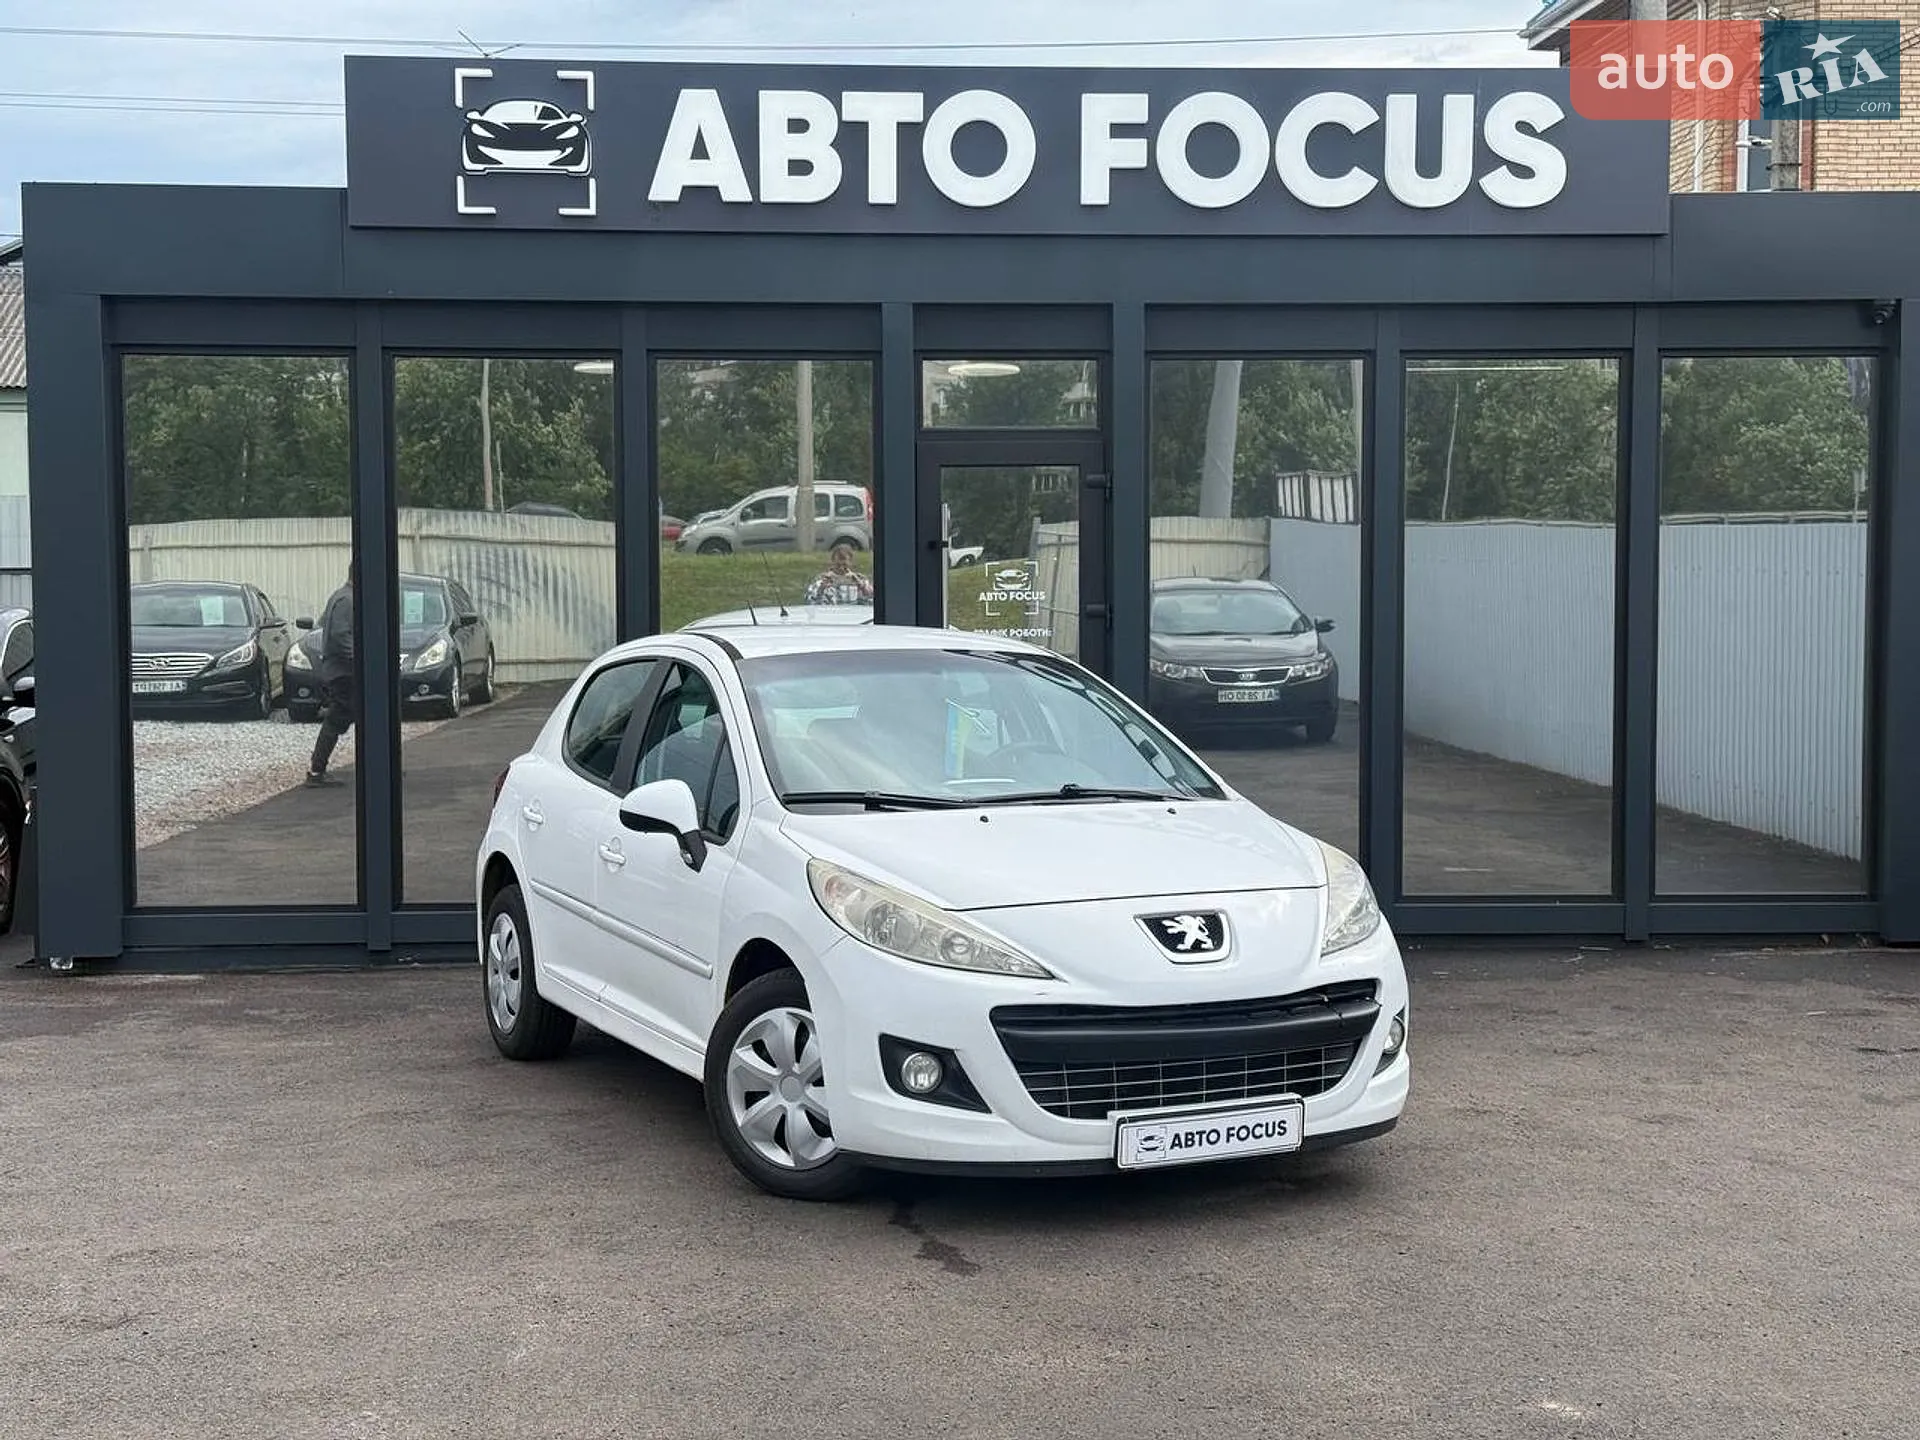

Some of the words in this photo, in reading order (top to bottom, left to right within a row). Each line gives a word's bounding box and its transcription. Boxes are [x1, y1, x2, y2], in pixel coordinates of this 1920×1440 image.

[647, 88, 1037, 208] АВТО
[1080, 91, 1568, 208] FOCUS
[979, 591, 1008, 601] АВТО
[1009, 591, 1046, 601] FOCUS
[1169, 1128, 1221, 1150] АВТО
[1225, 1119, 1288, 1144] FOCUS
